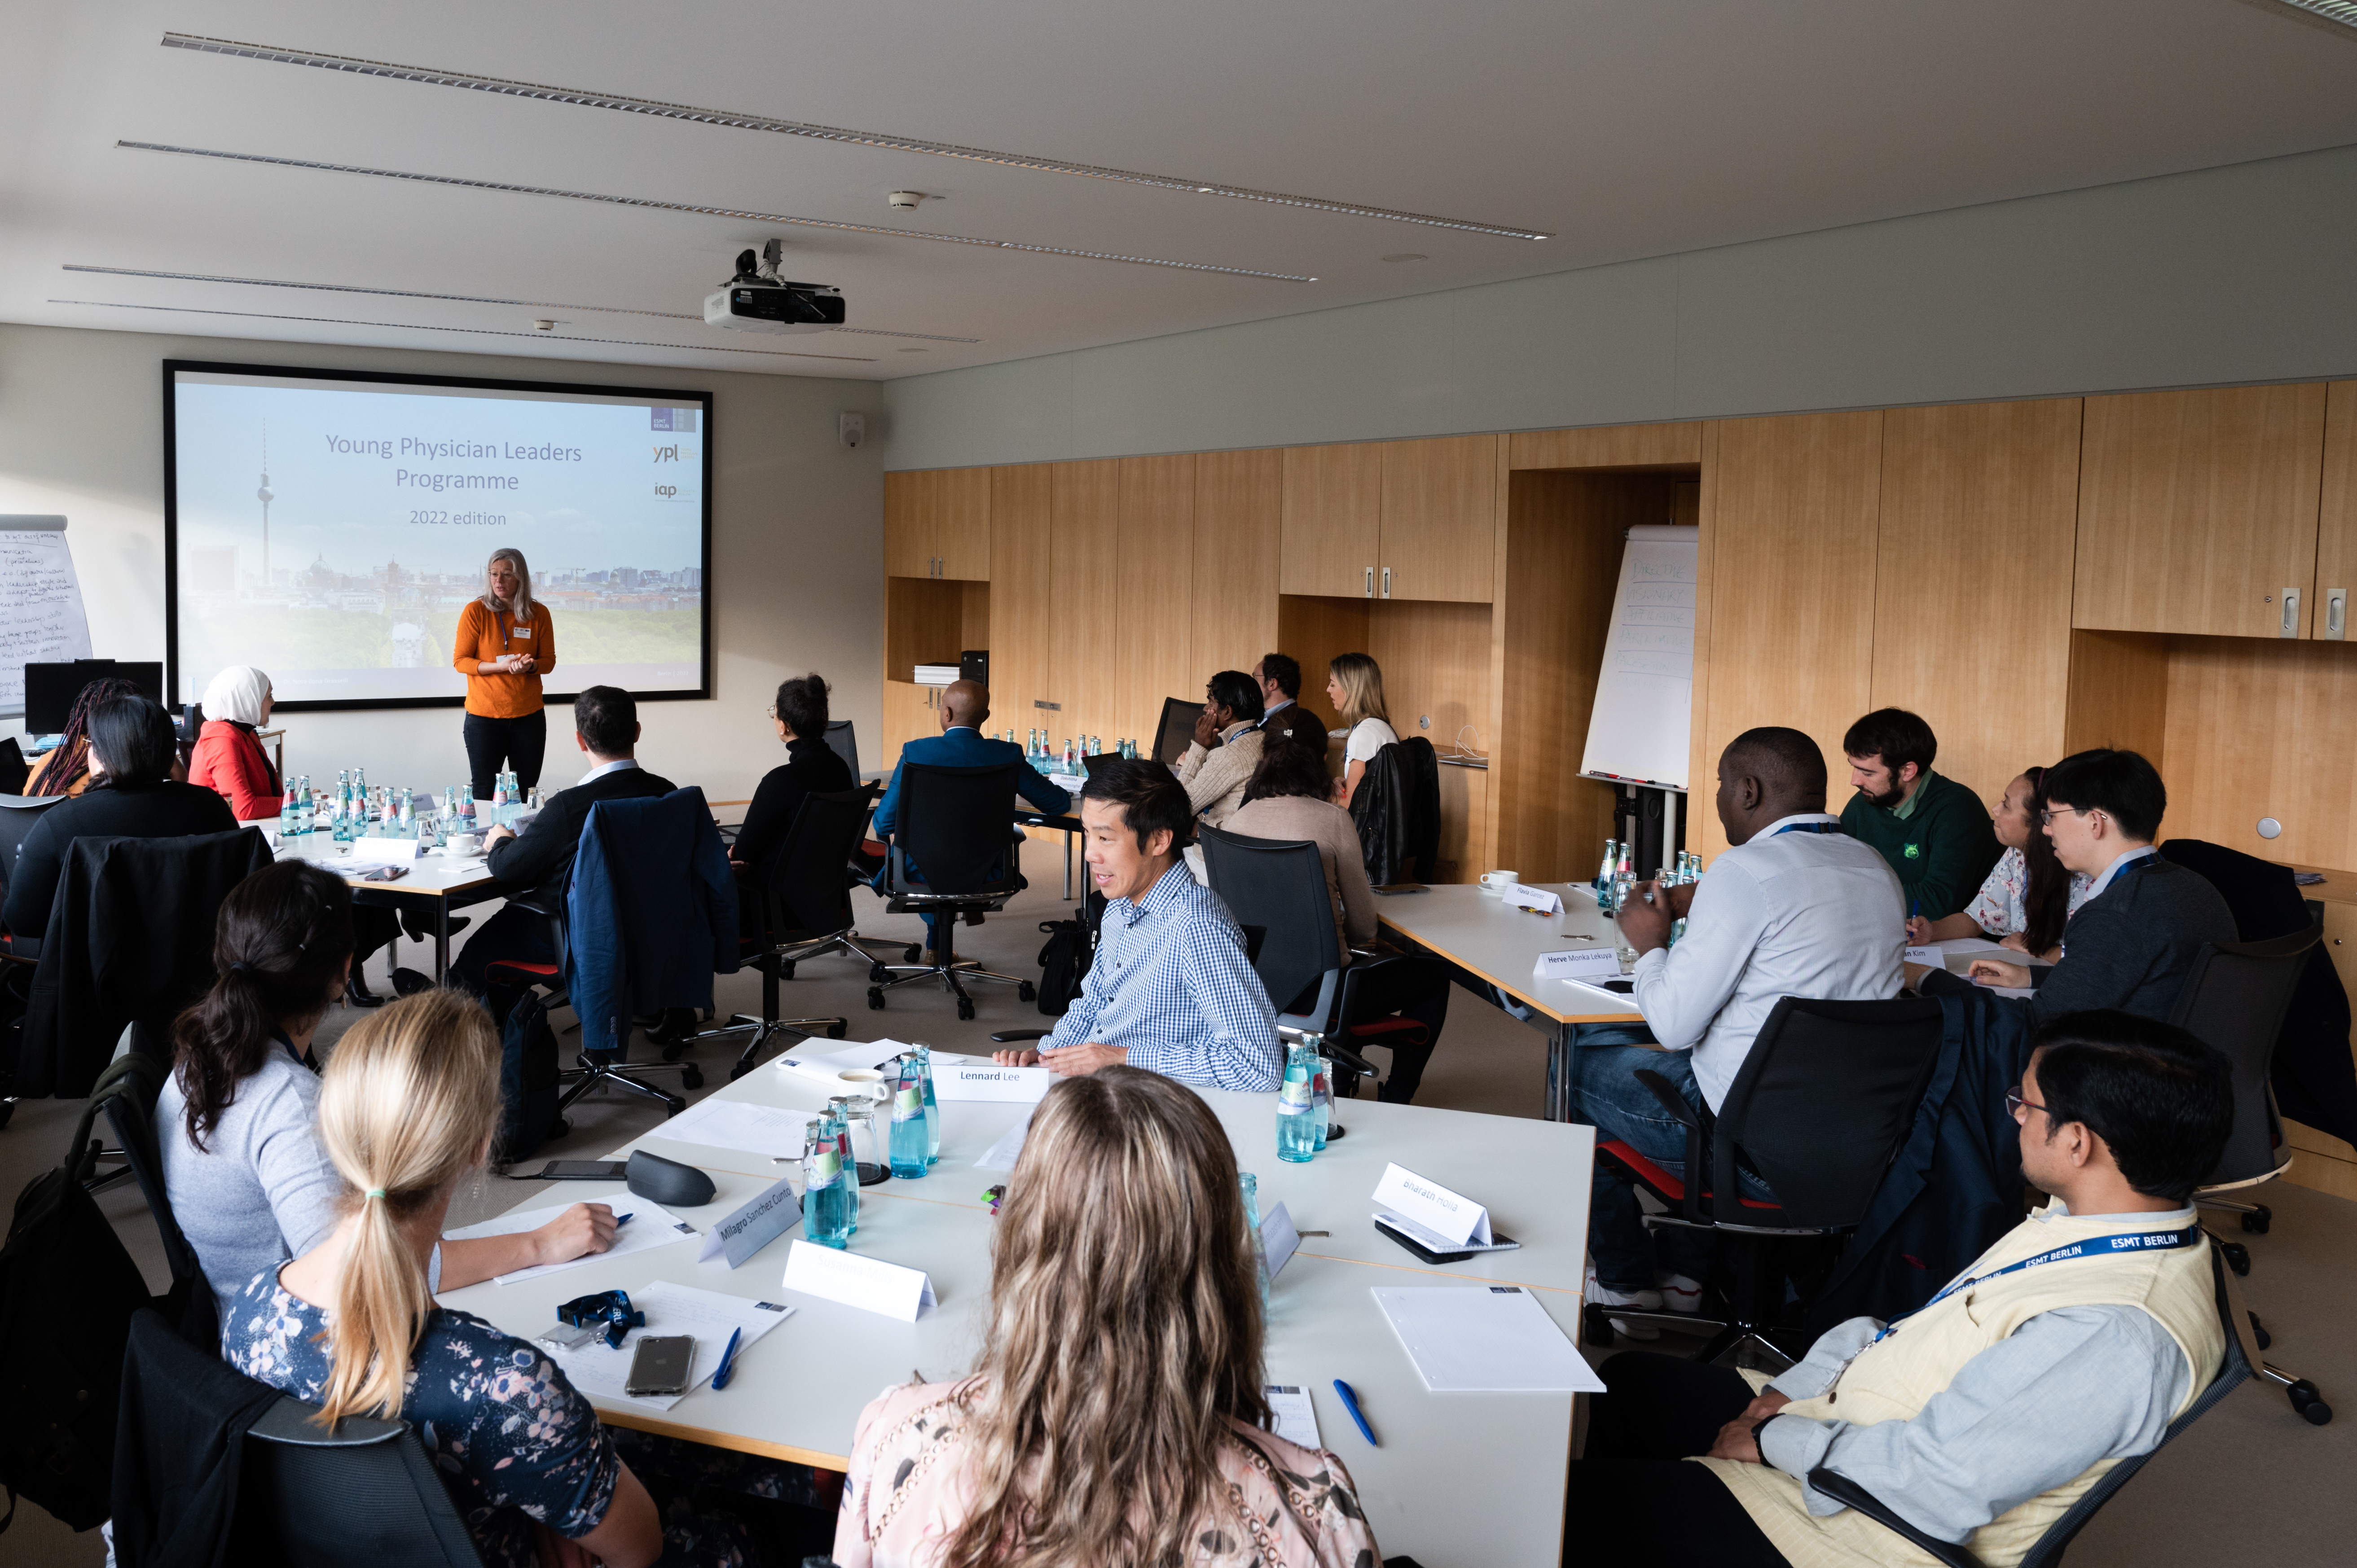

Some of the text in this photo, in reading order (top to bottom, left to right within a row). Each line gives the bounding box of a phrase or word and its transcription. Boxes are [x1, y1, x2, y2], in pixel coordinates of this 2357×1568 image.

[325, 435, 582, 461] Young Physician Leaders
[653, 444, 679, 463] ypl
[396, 469, 519, 492] Programme
[655, 482, 677, 499] iap
[409, 510, 507, 525] 2022 edition
[1517, 887, 1544, 899] Flavia Garcez
[961, 1071, 1020, 1081] Lennard Lee
[1403, 1178, 1458, 1212] Bharath Holla
[720, 1188, 791, 1242] Milagro Sanchez Cunto
[2111, 1234, 2178, 1249] ESMT BERLIN
[2025, 1245, 2082, 1269] ESMT BERLIN
[817, 1254, 893, 1284] Susanna Mills
